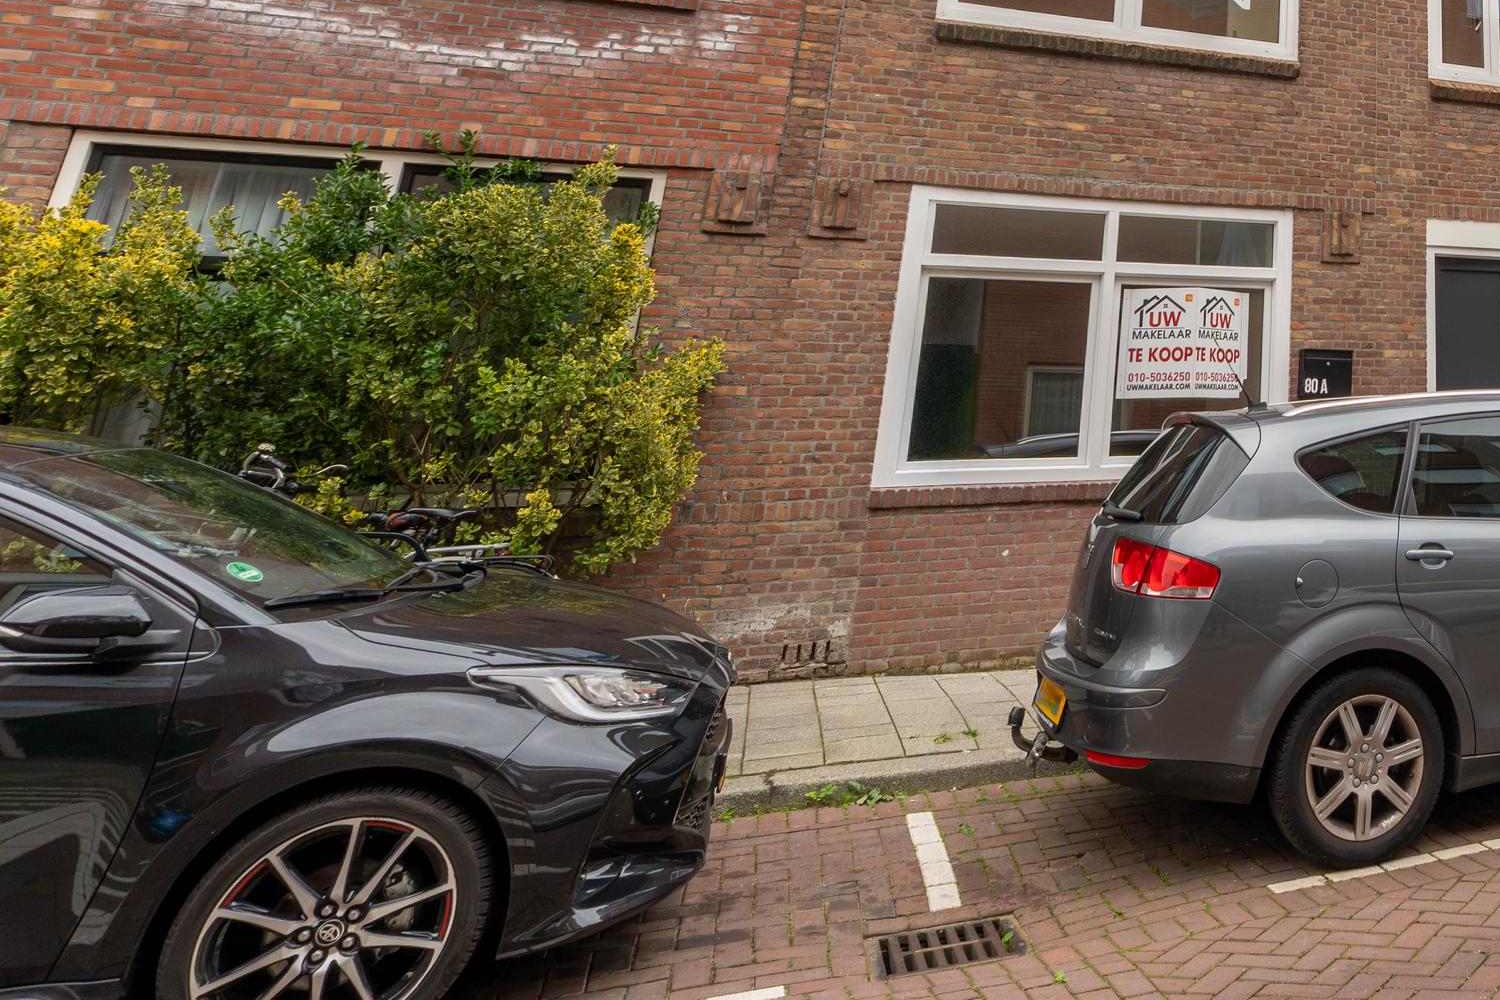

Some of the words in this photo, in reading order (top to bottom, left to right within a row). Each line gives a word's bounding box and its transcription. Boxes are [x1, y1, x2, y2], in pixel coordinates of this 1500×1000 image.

[1149, 311, 1181, 327] UW
[1210, 312, 1232, 328] UW
[1132, 329, 1192, 340] MAKELAAR
[1198, 329, 1239, 341] MAKELAAR
[1128, 348, 1143, 363] TE
[1148, 346, 1194, 363] KOOP
[1195, 347, 1206, 362] TE
[1209, 347, 1240, 363] KOOP
[1128, 372, 1191, 383] 010-5036250
[1126, 383, 1191, 391] UWMAKELAAR.COM
[1194, 383, 1239, 391] UWMAKELAAR.COM
[1304, 377, 1319, 394] 80
[1320, 378, 1329, 395] A
